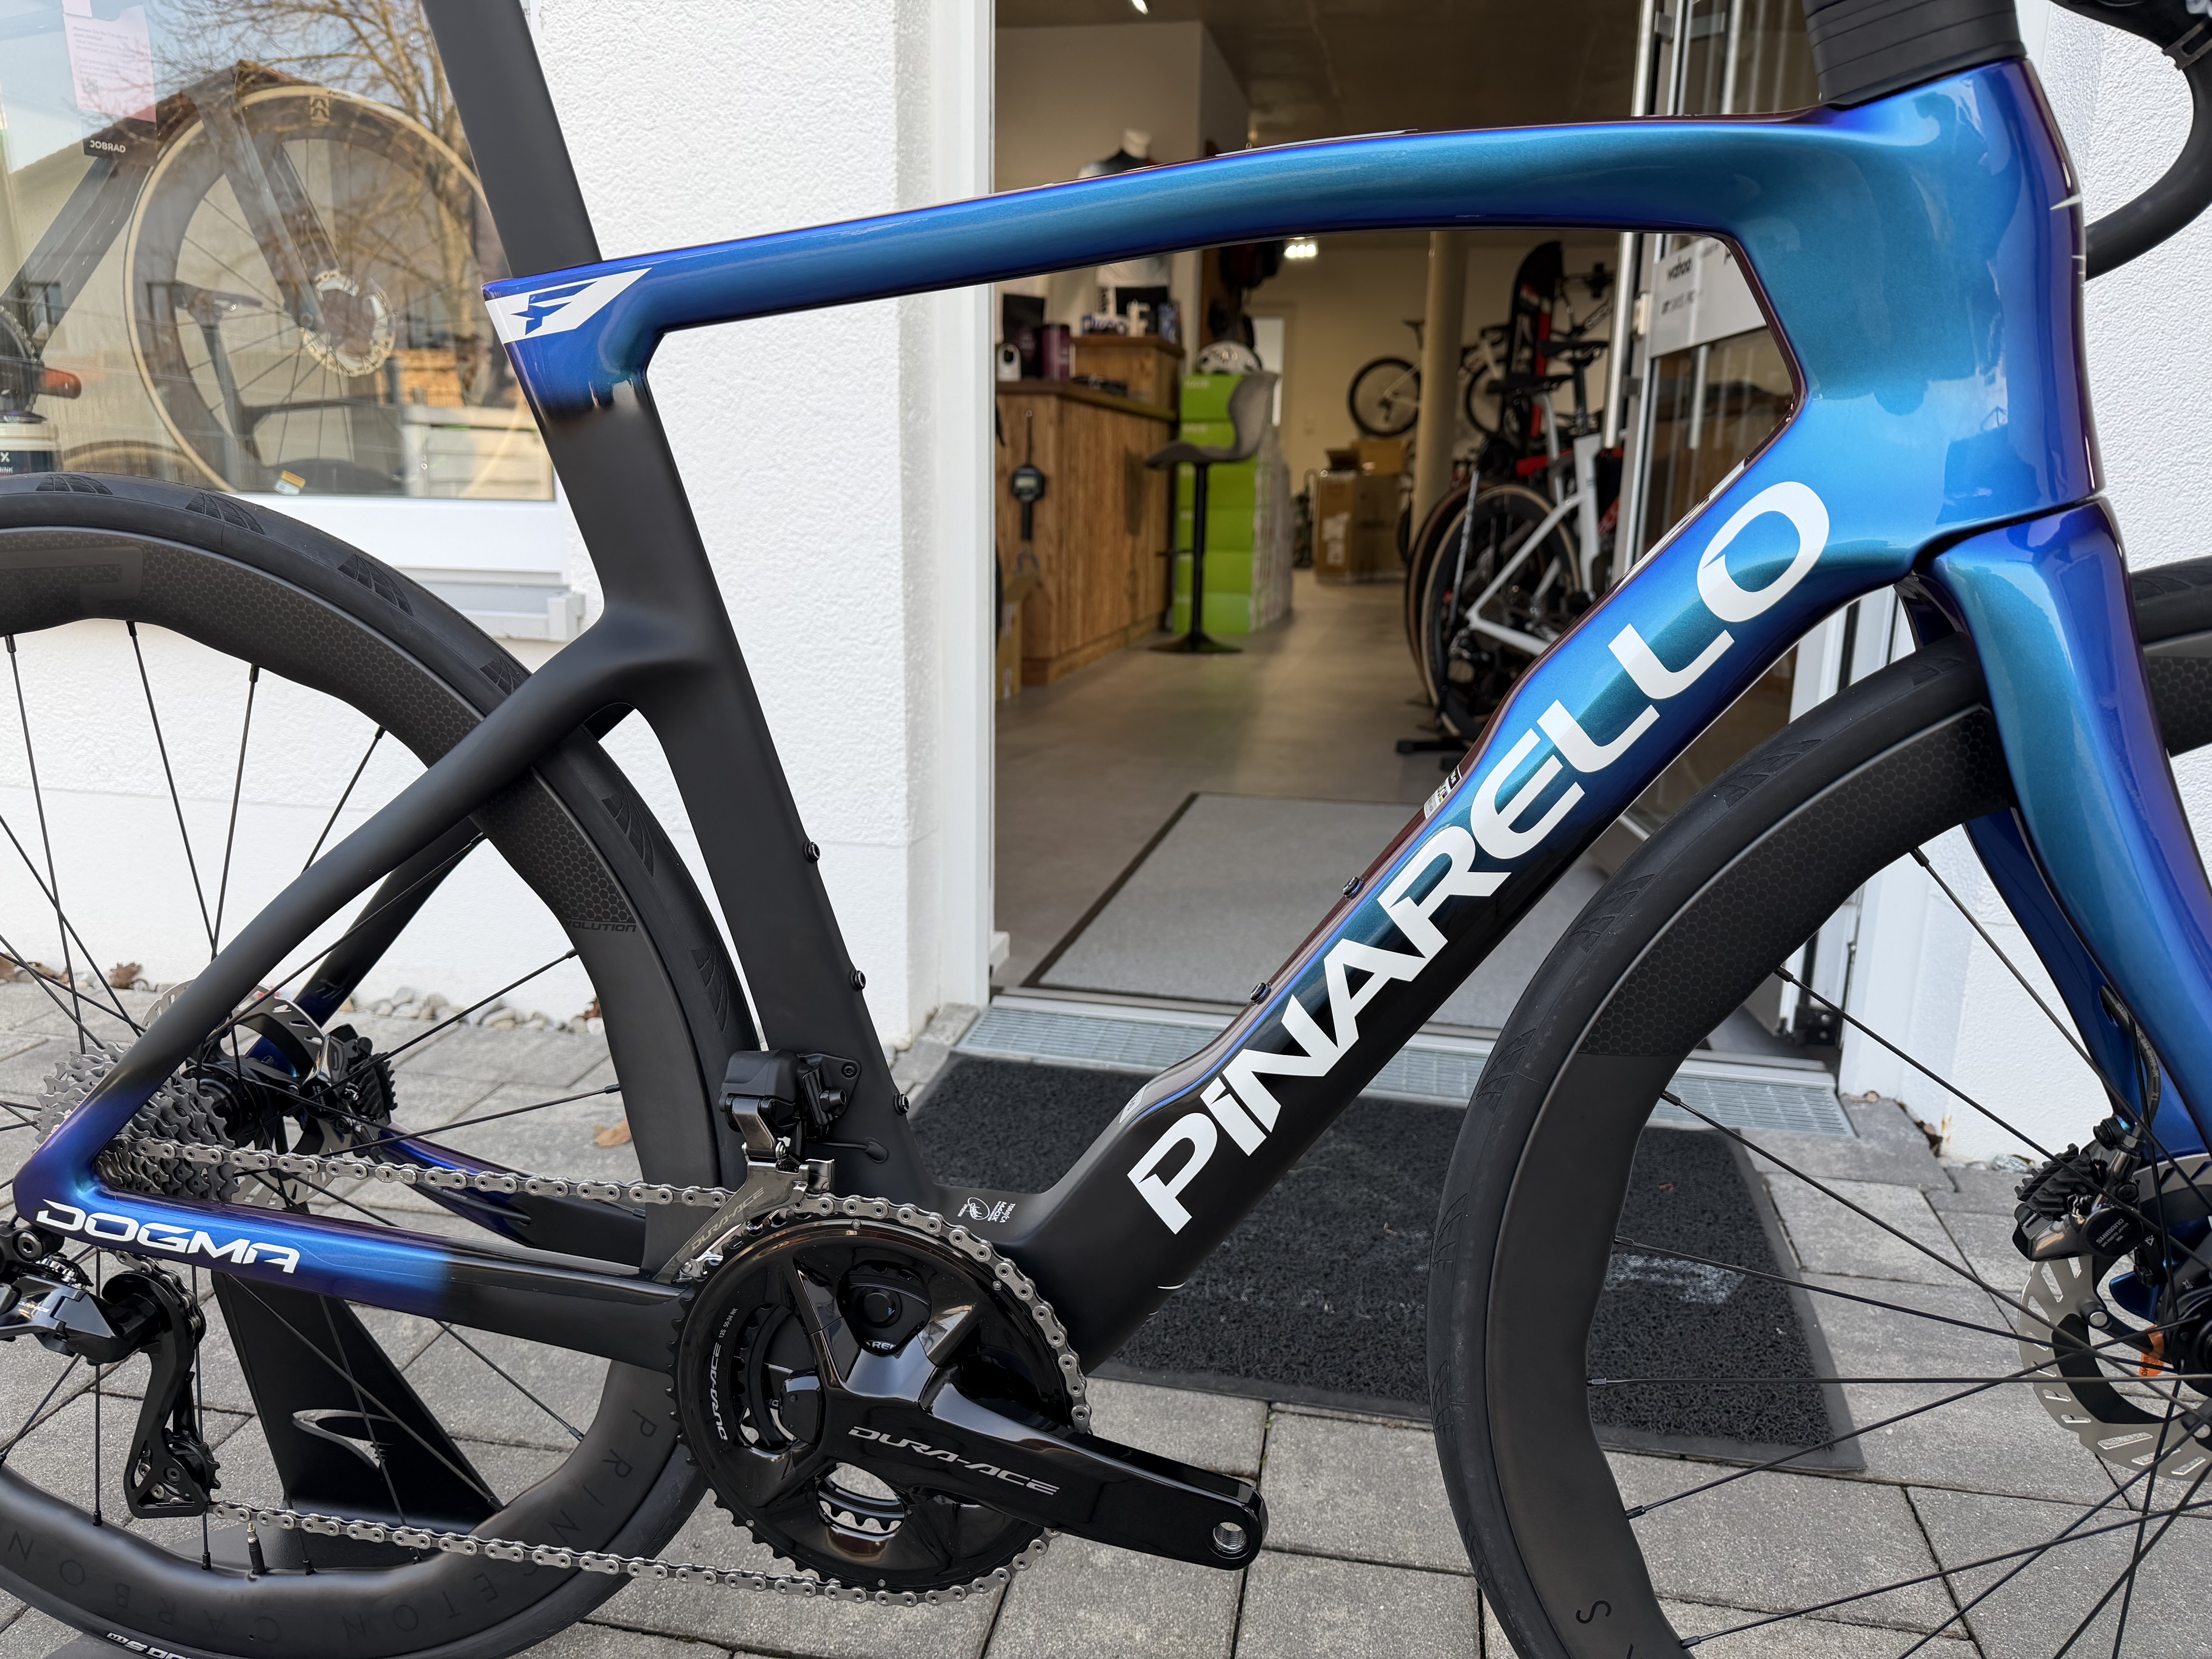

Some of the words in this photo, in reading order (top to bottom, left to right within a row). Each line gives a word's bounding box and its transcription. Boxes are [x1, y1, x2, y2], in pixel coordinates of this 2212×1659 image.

[89, 140, 126, 153] JOBRAD
[1127, 481, 1830, 1235] PINARELLO
[36, 1199, 300, 1273] DOGMA
[691, 1187, 764, 1251] DURA-ACE
[2096, 1218, 2124, 1244] SHIMANO
[723, 1315, 733, 1328] 50-34
[710, 1342, 728, 1441] DURA-ACE
[848, 1426, 1060, 1496] DURA-ACE
